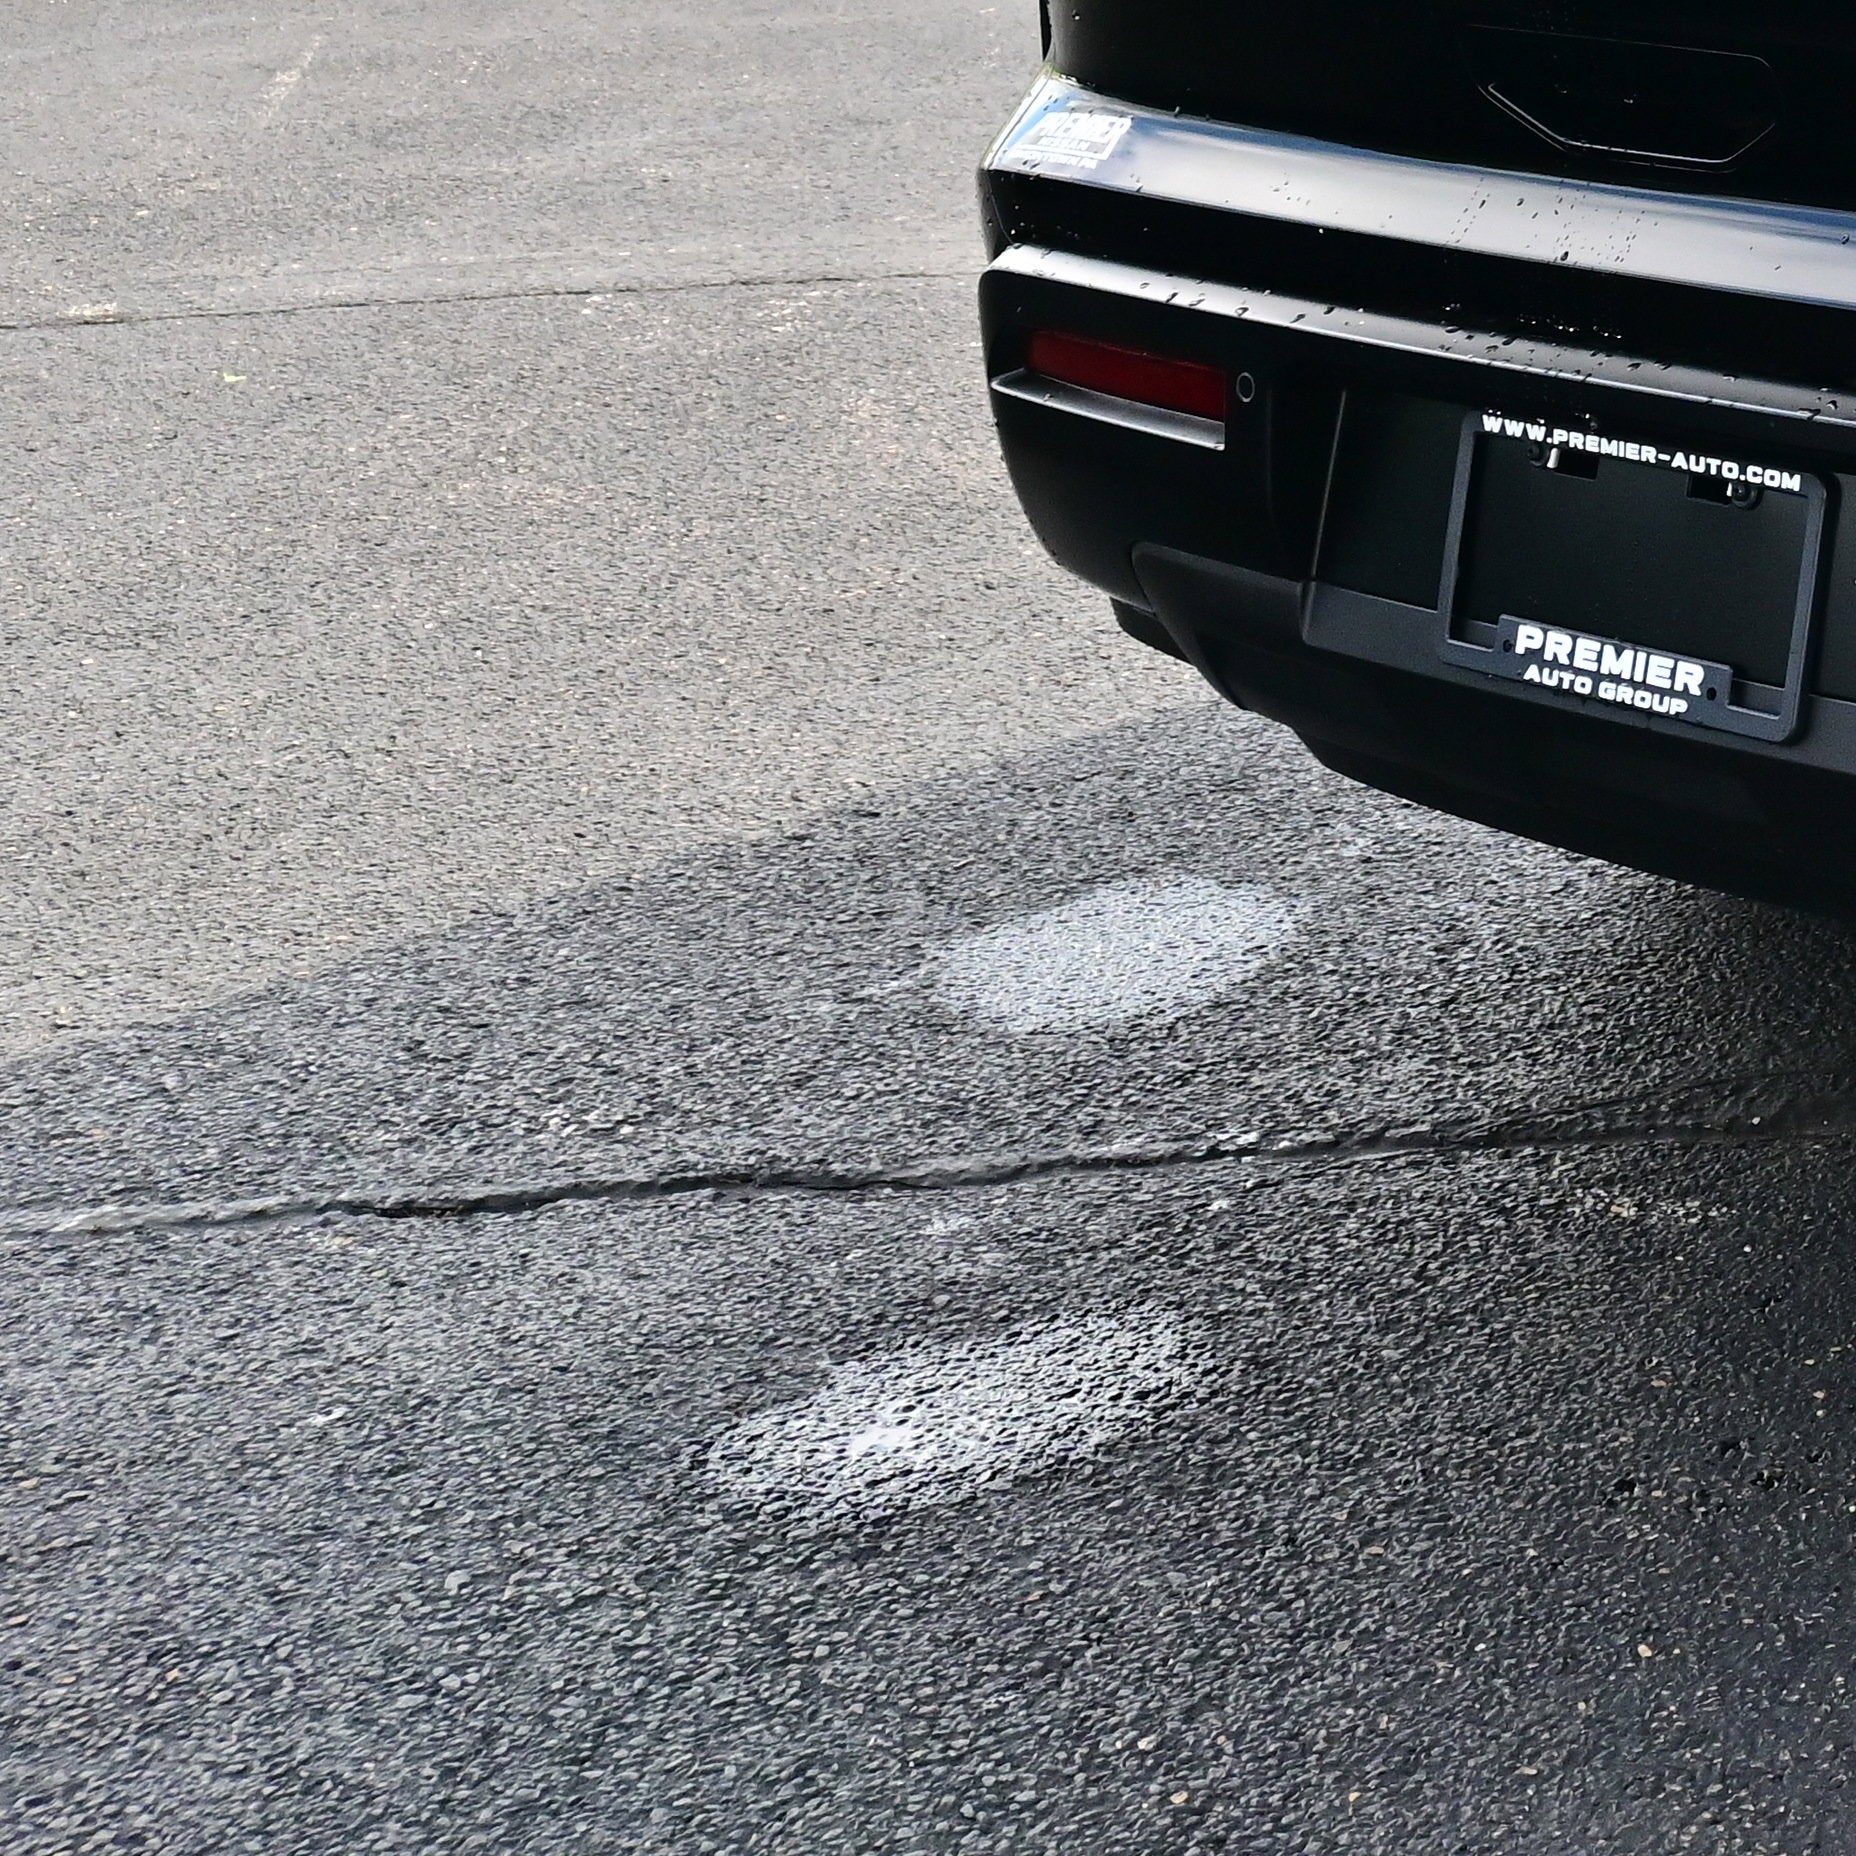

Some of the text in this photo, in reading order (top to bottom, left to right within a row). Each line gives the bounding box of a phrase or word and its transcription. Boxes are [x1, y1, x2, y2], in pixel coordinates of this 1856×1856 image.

[1482, 413, 1802, 493] WWW.PREMIER-AUTO.COM
[1514, 624, 1704, 696] PREMIER
[1523, 663, 1689, 716] AUTO GROUP
